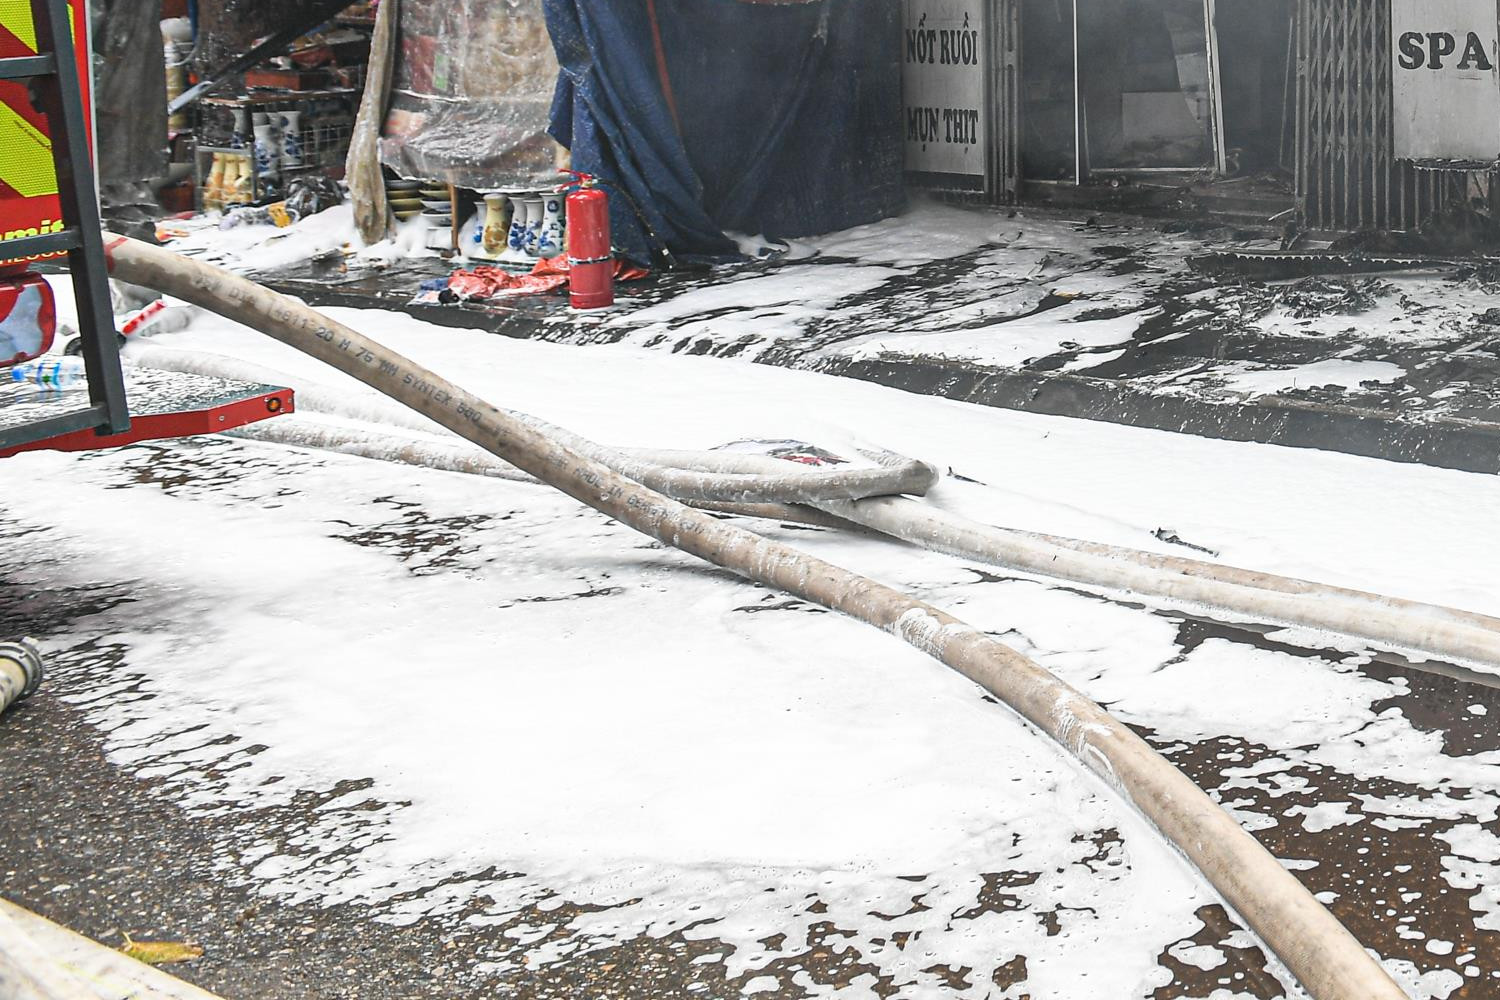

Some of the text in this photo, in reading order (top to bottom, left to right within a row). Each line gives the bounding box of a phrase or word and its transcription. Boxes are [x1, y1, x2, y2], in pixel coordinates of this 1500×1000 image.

[906, 12, 978, 65] NỐT RUỒI
[1398, 31, 1493, 71] SPA
[942, 108, 979, 154] THỊT
